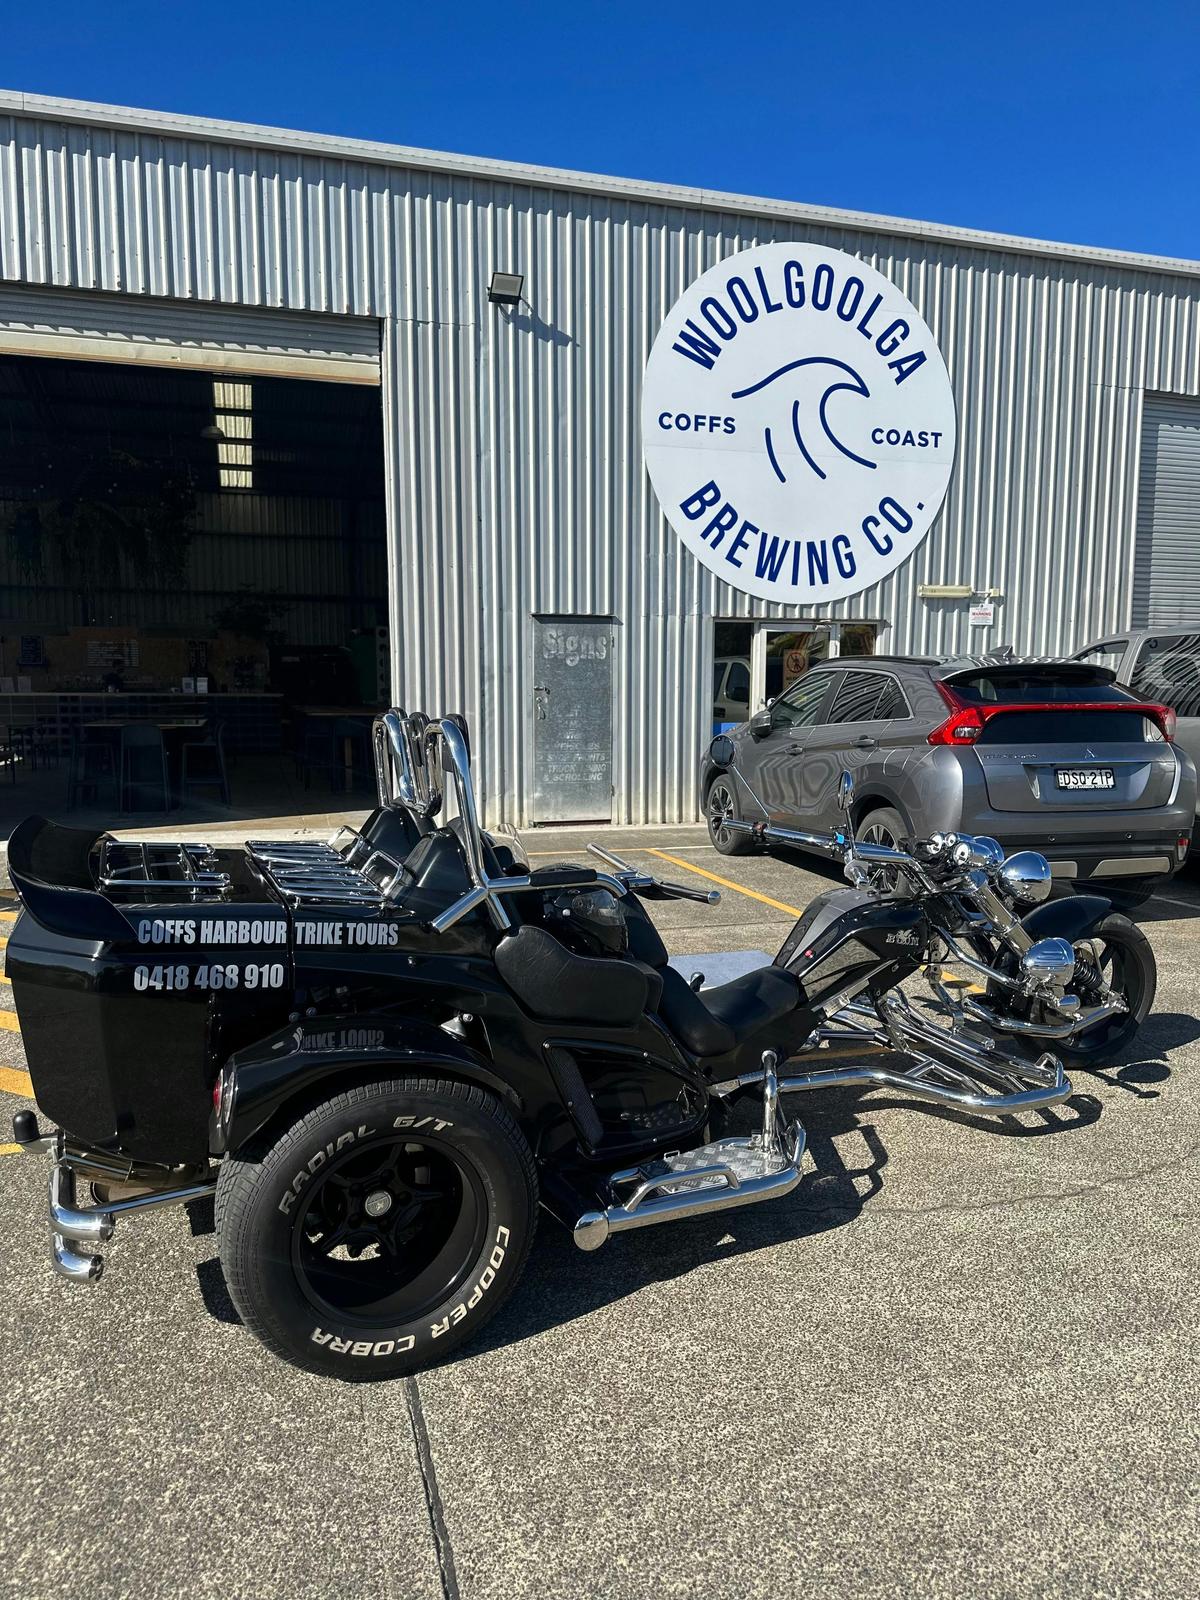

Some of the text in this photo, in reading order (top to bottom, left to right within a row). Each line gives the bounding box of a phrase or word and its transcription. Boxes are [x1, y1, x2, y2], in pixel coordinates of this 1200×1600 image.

[672, 260, 927, 385] WOOLGOOLGA
[658, 411, 943, 448] COFFS COAST
[679, 480, 925, 586] BREWING CO.
[543, 629, 607, 667] Signs
[138, 919, 399, 946] COFFS HARBOUR TRIKE TOURS
[133, 963, 284, 991] 0418 468 910
[278, 1115, 454, 1215] RADIAL G/T
[311, 1225, 511, 1357] COOPER COBRA
